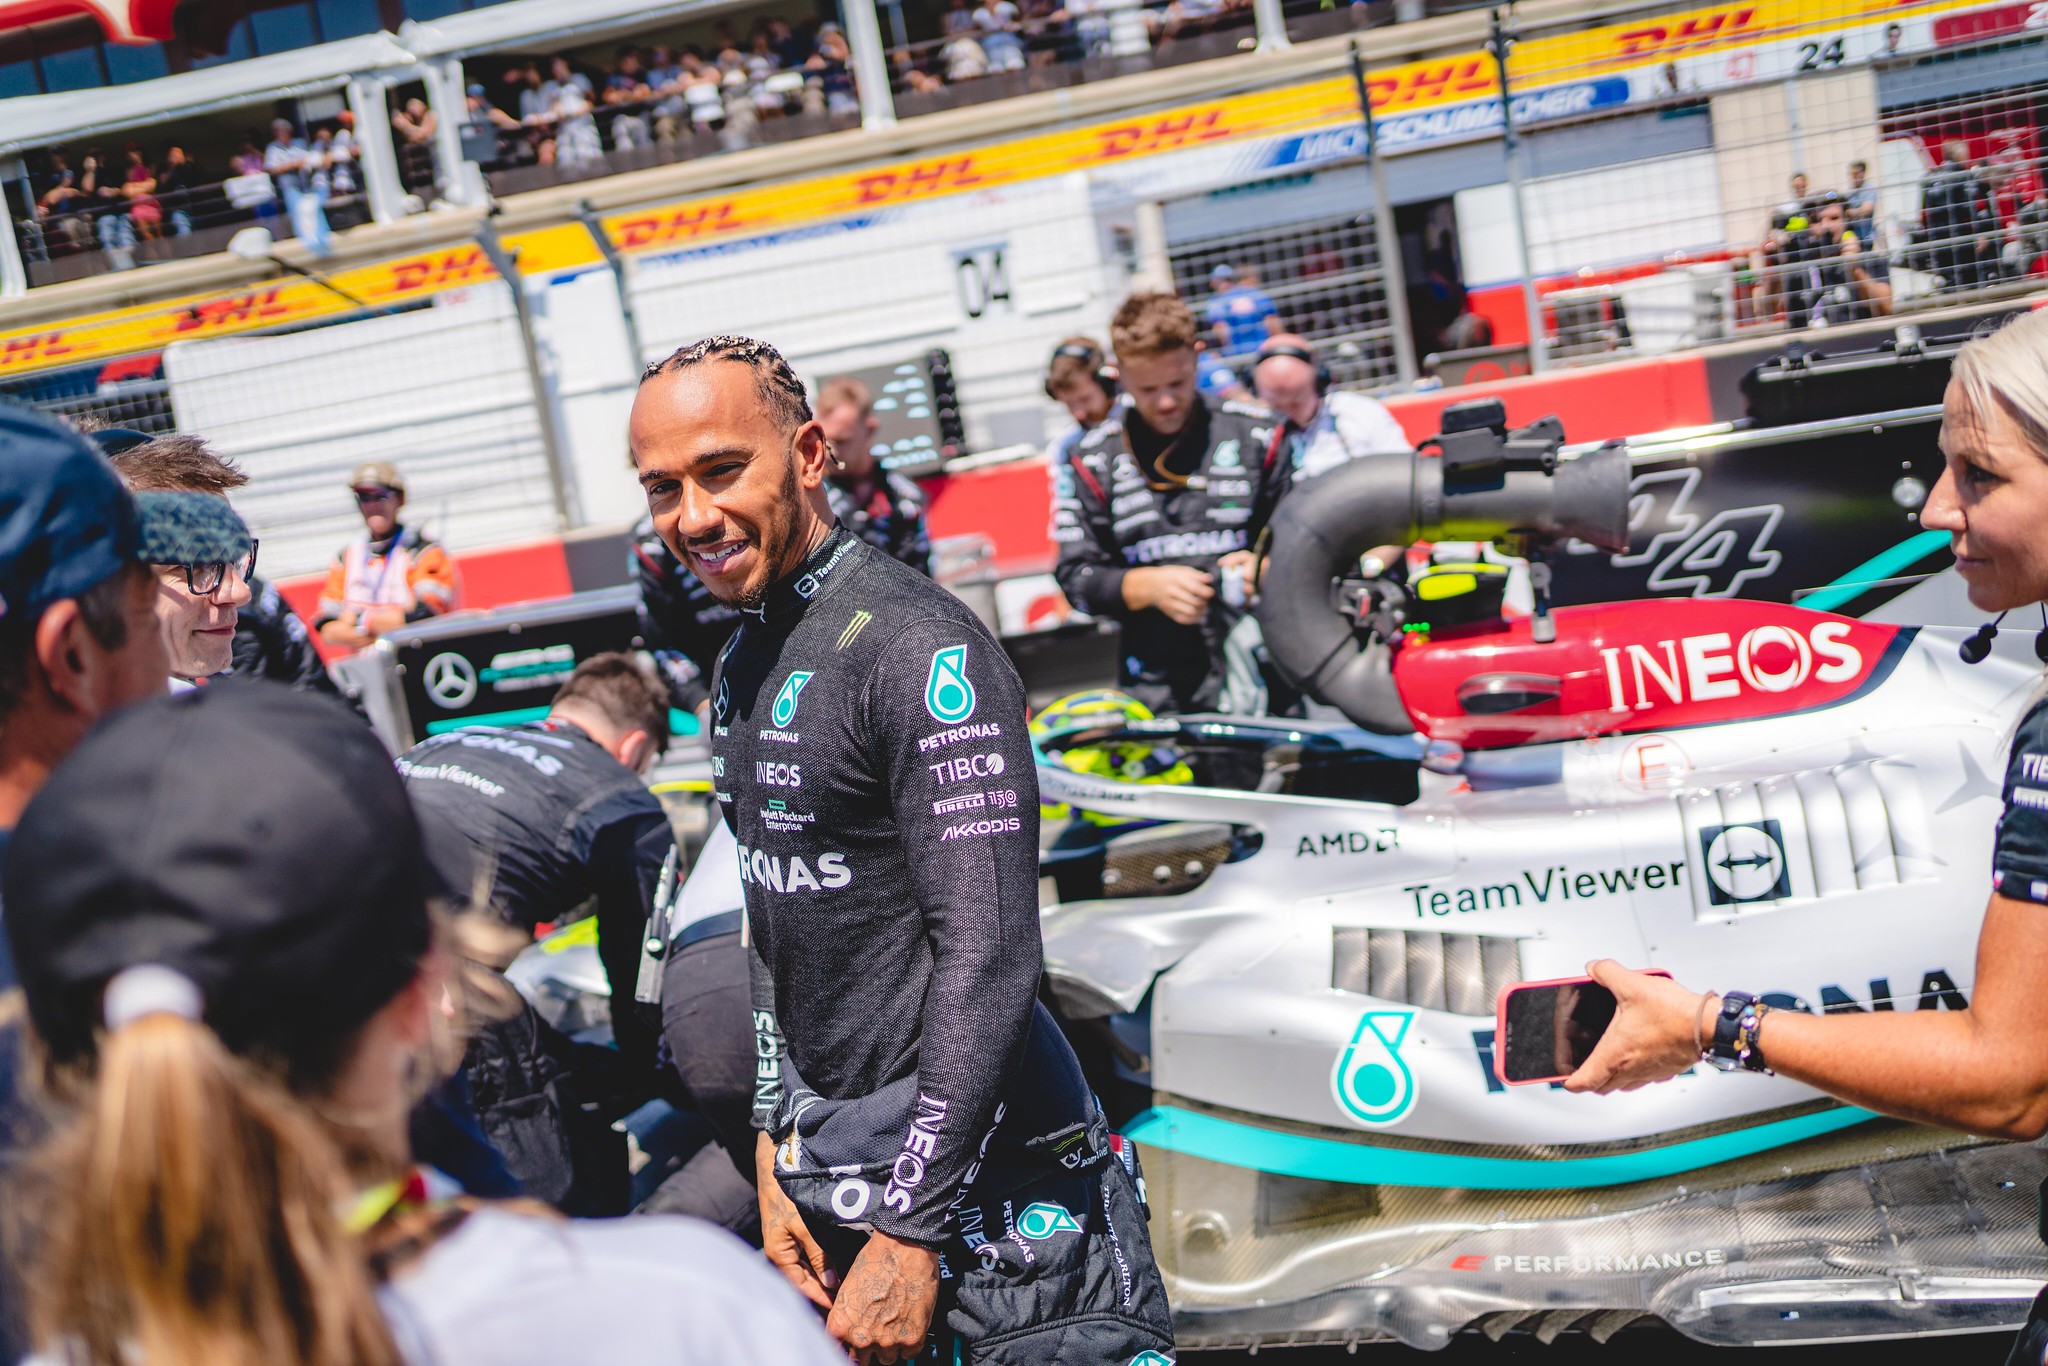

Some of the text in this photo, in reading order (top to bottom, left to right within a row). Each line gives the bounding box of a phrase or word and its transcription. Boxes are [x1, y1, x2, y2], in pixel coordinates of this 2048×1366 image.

[1612, 8, 1762, 58] DHL
[1798, 36, 1845, 71] 24
[1361, 61, 1492, 110] DHL
[1099, 110, 1231, 157] DHL
[856, 158, 982, 203] DHL
[617, 203, 742, 248] DHL
[393, 250, 498, 291] DHL
[1599, 621, 1863, 713] INEOS
[759, 729, 799, 744] PETRONAS
[918, 722, 1001, 752] PETRONAS
[394, 757, 506, 797] TeamViewer
[756, 761, 801, 787] INEOS
[929, 752, 1004, 784] TIBCO
[778, 810, 815, 822] Packard
[932, 793, 985, 815] PIRELLI
[765, 818, 803, 833] Enterprise
[1296, 832, 1369, 858] AMD
[1404, 861, 1684, 918] TeamViewer
[752, 1009, 779, 1111] INEOS
[884, 1091, 948, 1213] INEOS
[1003, 1199, 1035, 1263] PETRONAS
[1104, 1213, 1131, 1306] RITZ-CARLTON
[1494, 1249, 1723, 1273] PERFORMANCE
